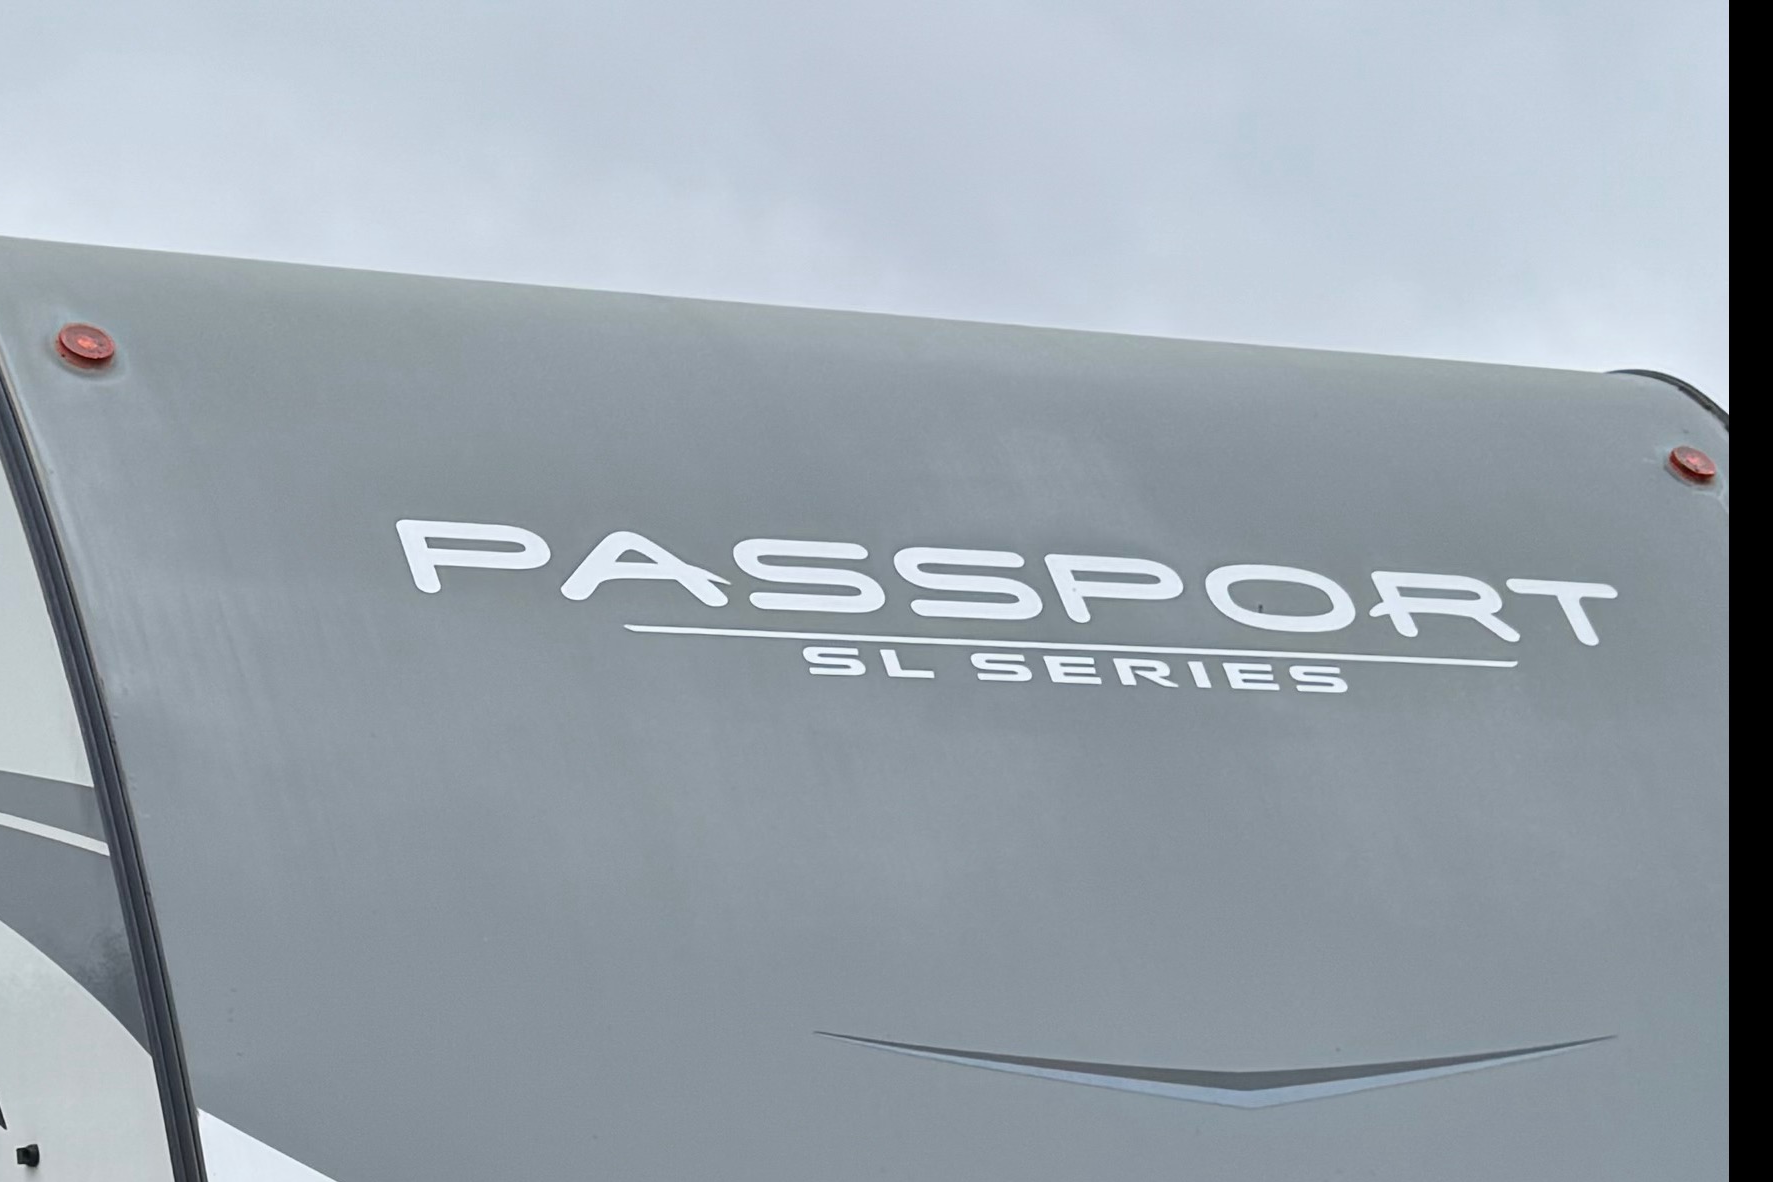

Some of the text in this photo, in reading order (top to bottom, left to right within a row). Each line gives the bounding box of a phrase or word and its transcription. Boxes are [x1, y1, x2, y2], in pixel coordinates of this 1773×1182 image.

[395, 519, 1619, 647] PASSPORT
[802, 645, 1349, 694] SL SERIES
